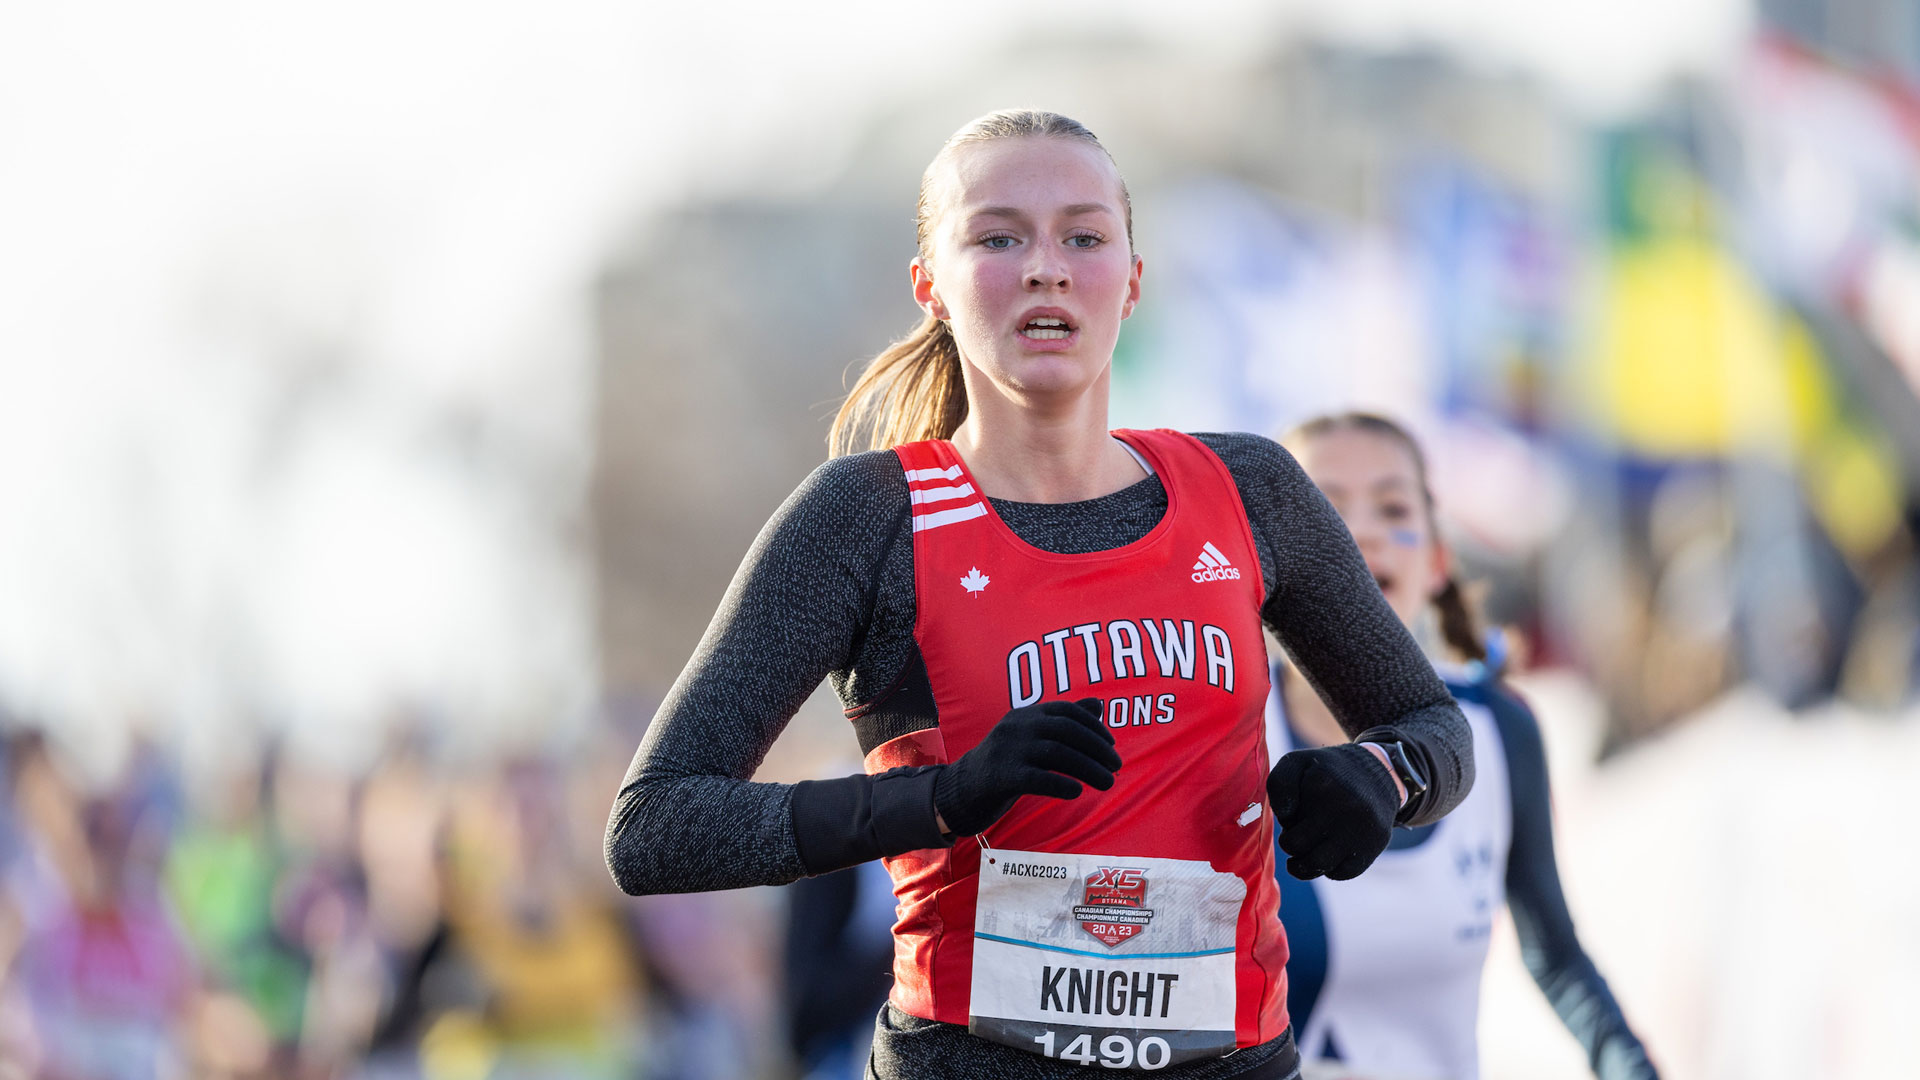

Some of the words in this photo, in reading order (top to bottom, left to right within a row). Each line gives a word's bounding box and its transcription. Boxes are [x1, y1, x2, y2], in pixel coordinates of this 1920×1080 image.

[1191, 564, 1241, 583] adidas
[1007, 618, 1235, 710] OTTAWA
[1099, 693, 1176, 728] ONS
[1002, 862, 1067, 880] #ACXC2023
[1093, 867, 1145, 888] XC
[1076, 914, 1119, 922] CHAMPIONNAT
[1104, 908, 1153, 917] CHAMPIONSHIPS
[1092, 924, 1106, 934] 20
[1118, 926, 1132, 935] 23
[1040, 966, 1179, 1018] KNIGHT
[1034, 1031, 1171, 1070] 1490
